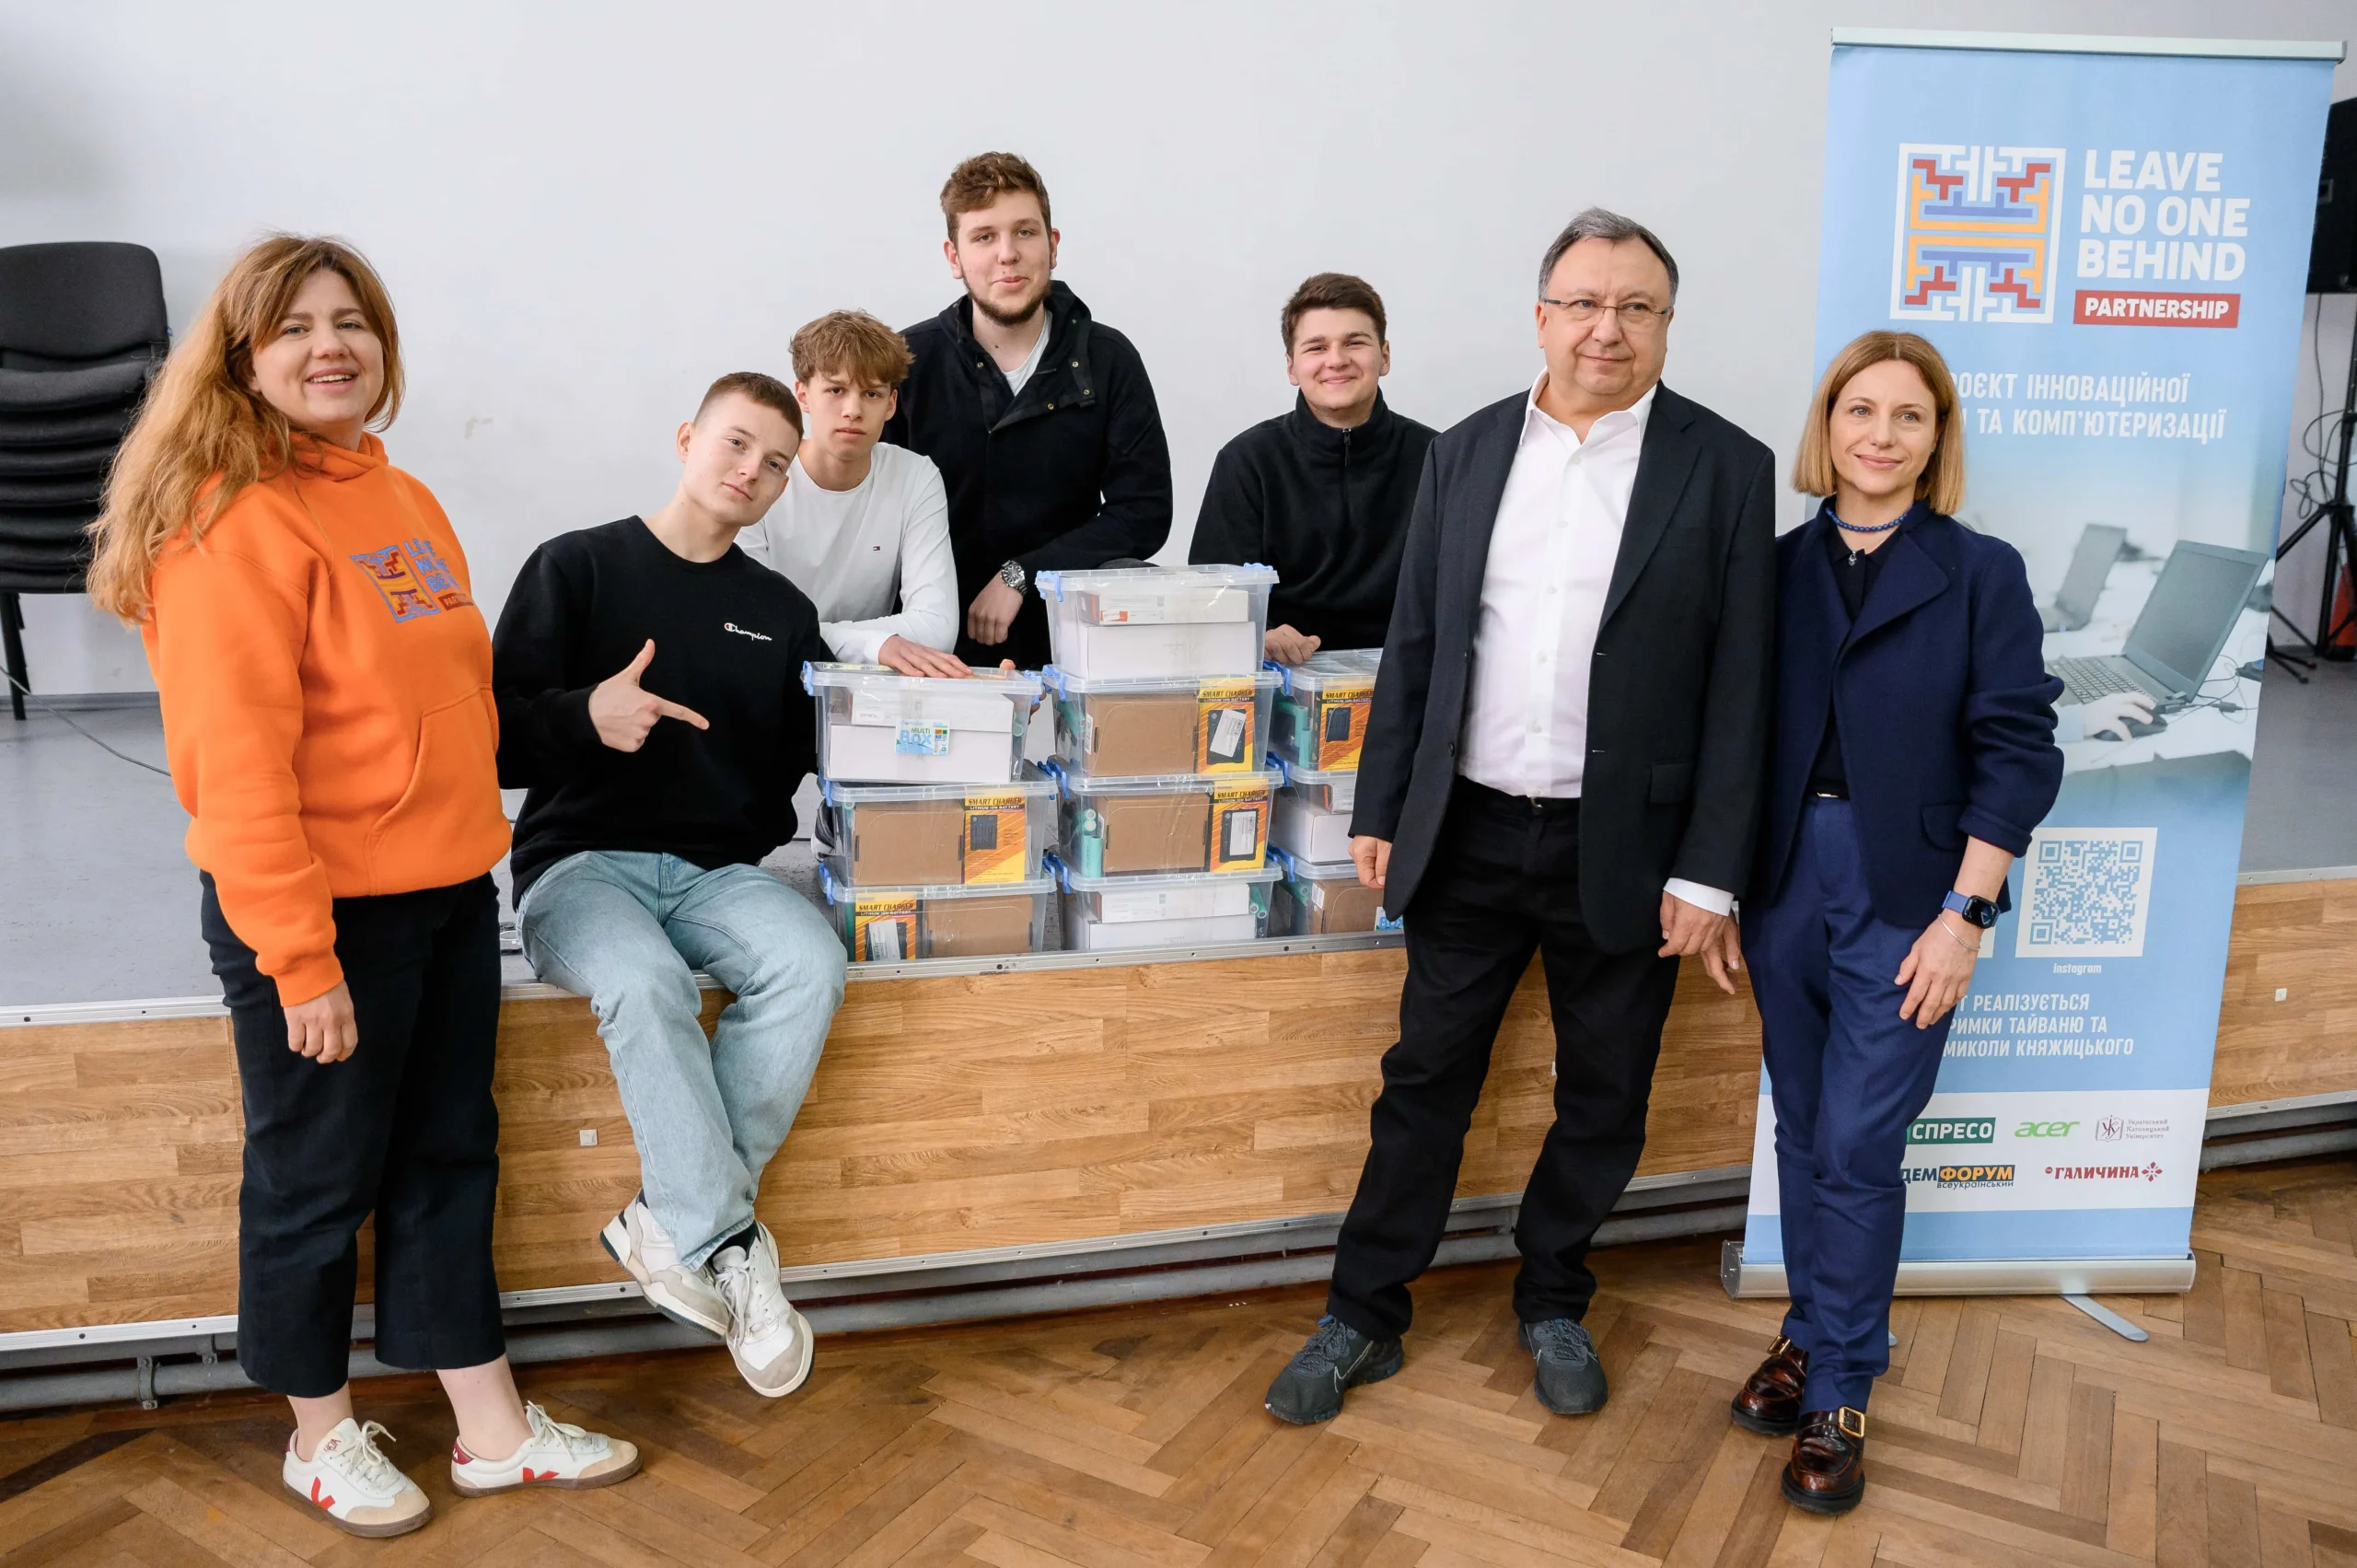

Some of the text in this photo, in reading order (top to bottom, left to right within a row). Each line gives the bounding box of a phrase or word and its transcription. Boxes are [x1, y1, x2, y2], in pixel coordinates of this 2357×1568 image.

[2084, 149, 2223, 192] LEAVE
[2080, 194, 2251, 238] NO ONE
[2077, 238, 2246, 281] BEHIND
[2084, 296, 2229, 319] PARTNERSHIP
[2026, 371, 2191, 408] ІННОВАЦІЙНОЇ
[1977, 408, 2003, 435] ТА
[724, 622, 772, 641] Champion
[883, 902, 913, 911] CHARGER
[2053, 963, 2102, 975] instagram
[1973, 993, 2090, 1012] РЕАЛІЗУЄТЬСЯ
[2009, 1014, 2084, 1034] ТАЙВАНЮ
[2091, 1016, 2107, 1033] ТА
[1943, 1038, 2134, 1059] МИКОЛИ КНЯЖИЦЬКОГО
[2014, 1121, 2081, 1138] acer
[2054, 1166, 2139, 1179] ГАЛИЧИНА
